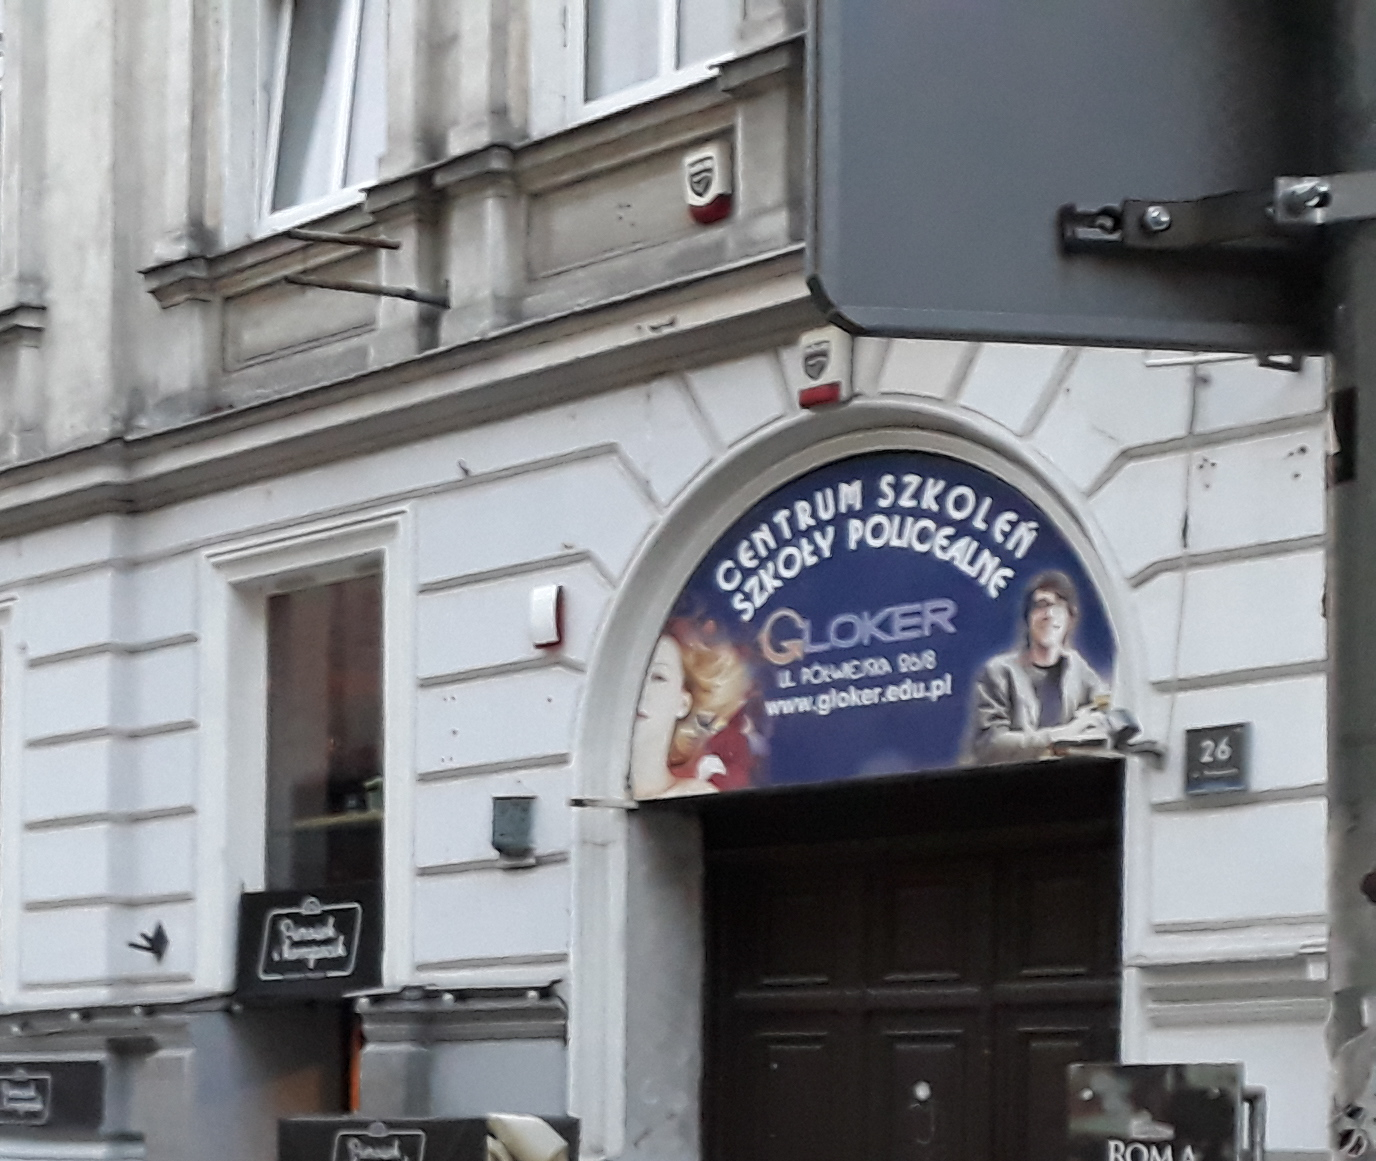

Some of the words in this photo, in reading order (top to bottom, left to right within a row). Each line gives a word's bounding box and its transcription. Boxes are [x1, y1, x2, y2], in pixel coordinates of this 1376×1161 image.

[716, 478, 863, 591] CENTRUM
[848, 515, 1016, 599] POLICEALNE
[877, 473, 1039, 559] SZKOLEŃ
[732, 526, 835, 622] SZKOŁY
[759, 598, 958, 665] GLOKER
[764, 672, 953, 716] www.gloker.edu.pl
[1199, 736, 1232, 763] 26
